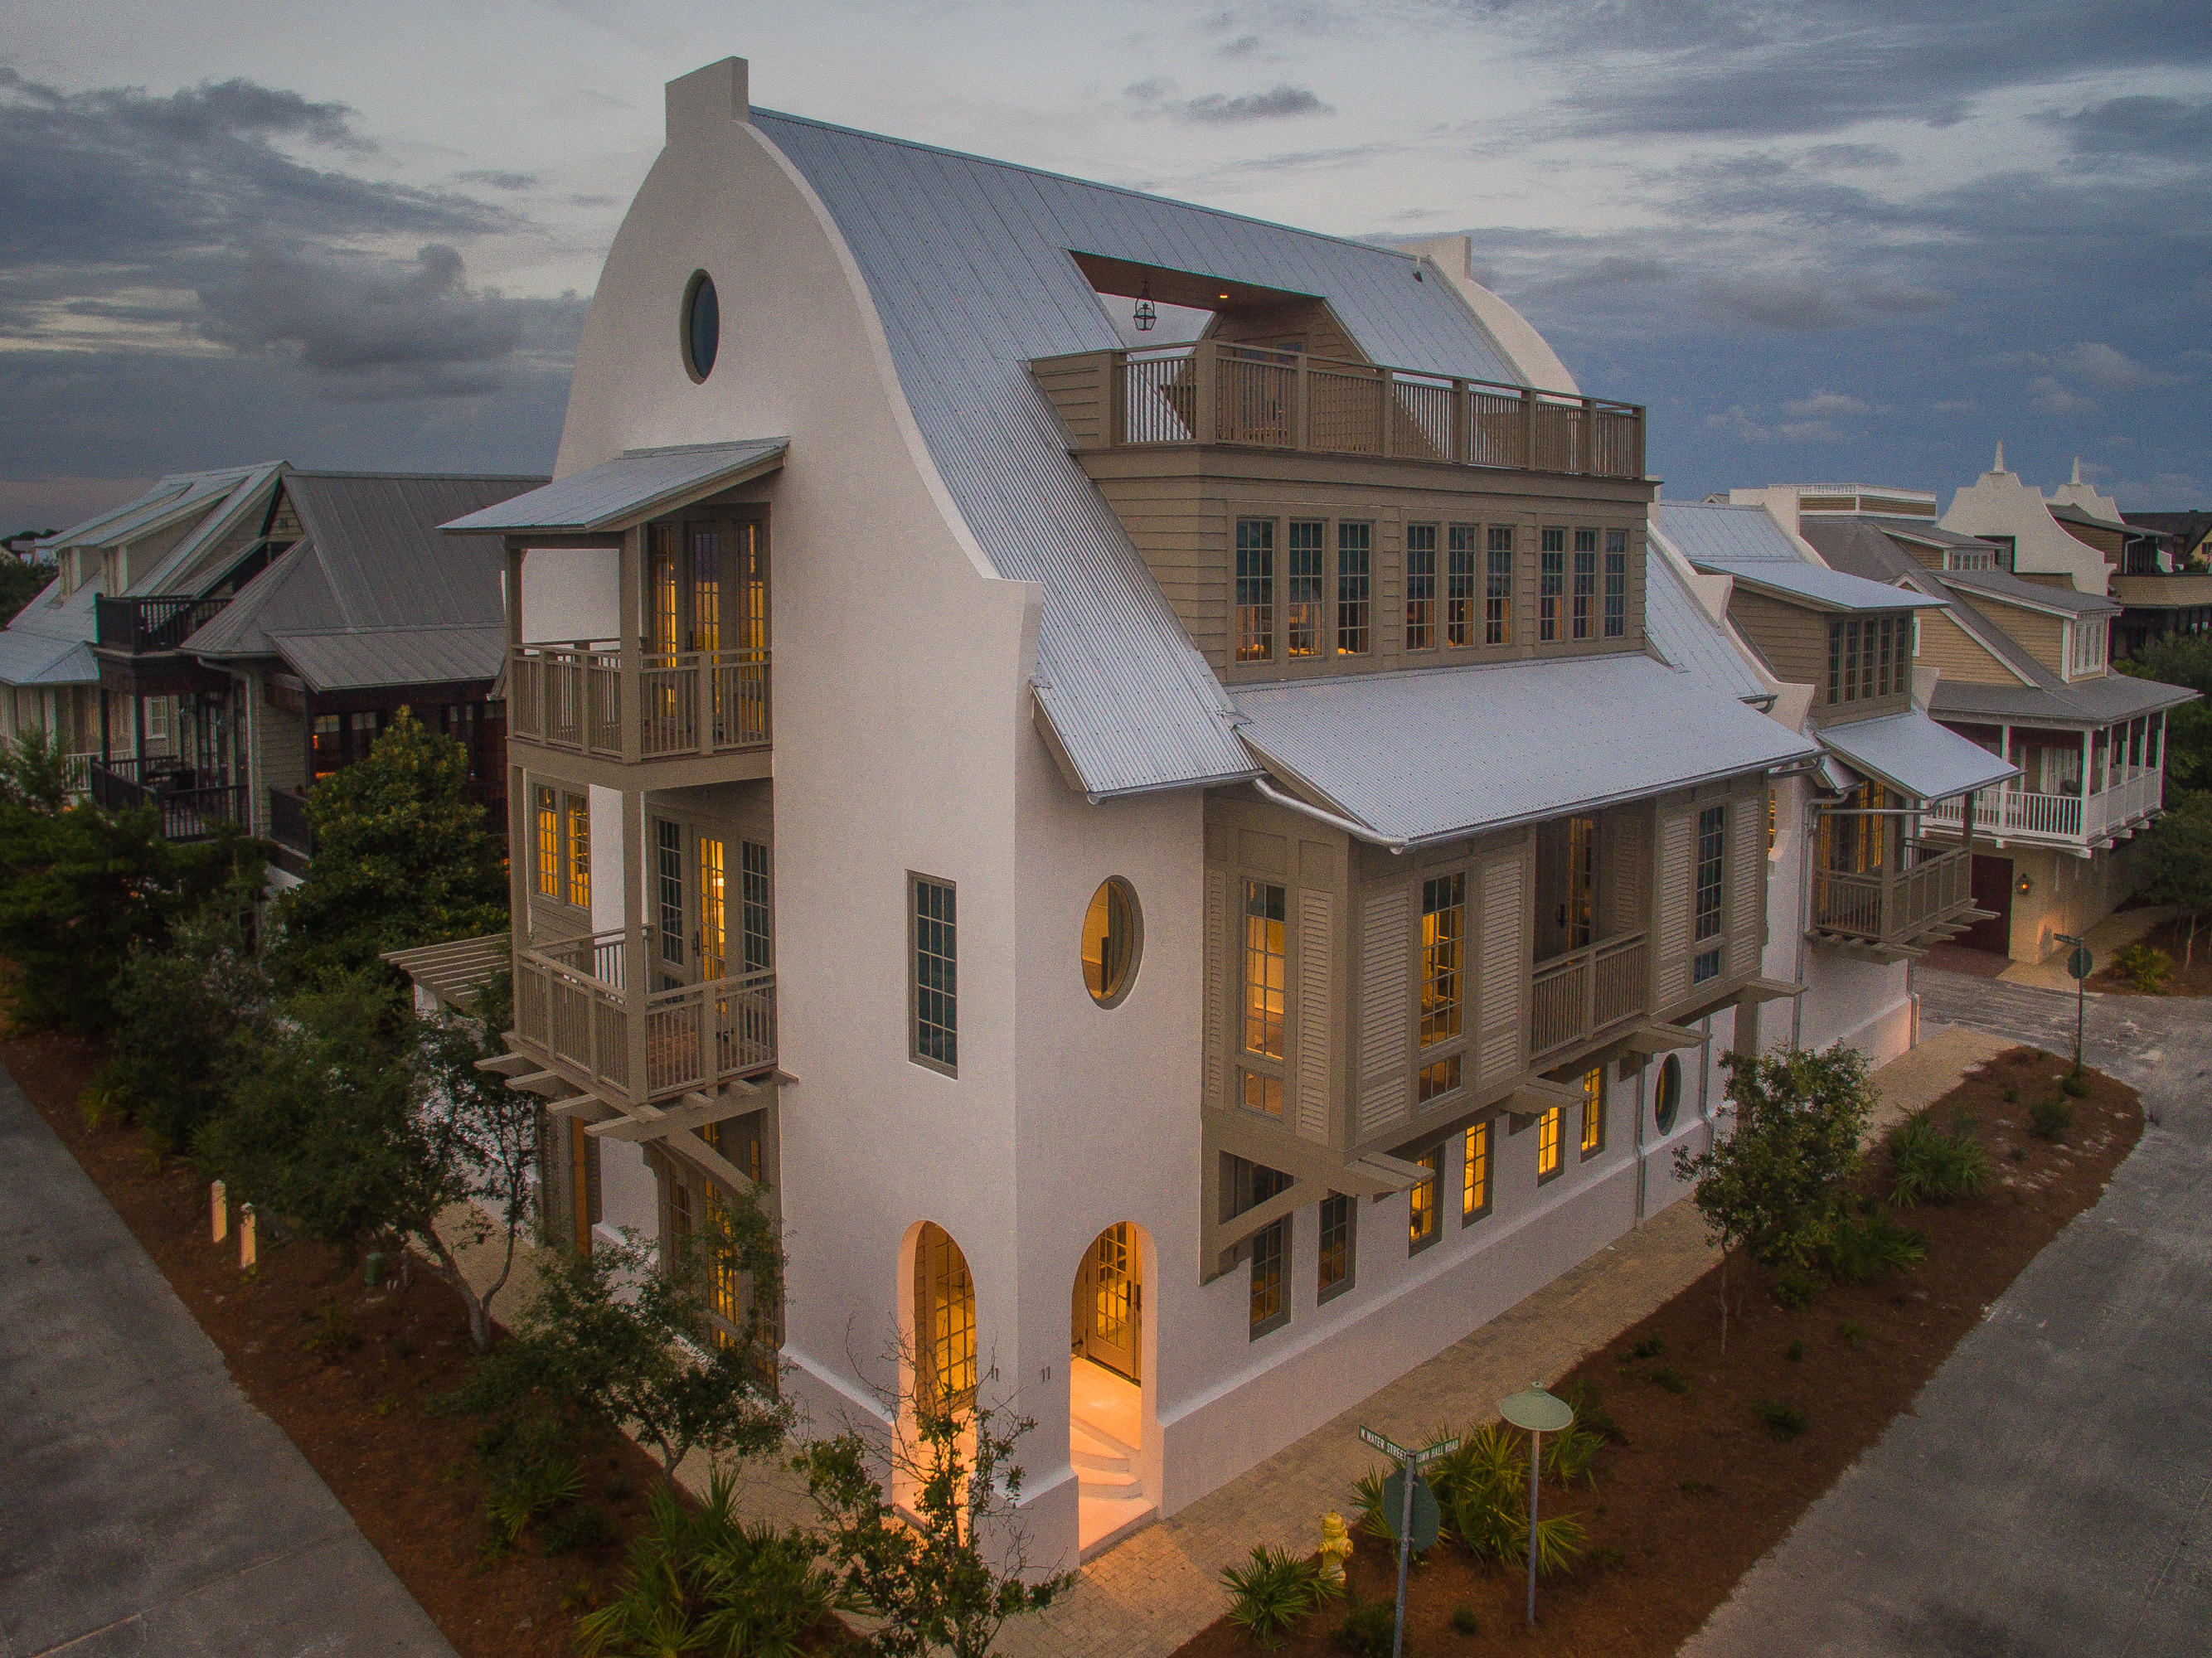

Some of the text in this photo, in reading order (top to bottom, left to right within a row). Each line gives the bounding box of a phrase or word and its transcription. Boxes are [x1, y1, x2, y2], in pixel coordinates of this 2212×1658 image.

[1366, 1431, 1385, 1450] WATER
[1386, 1442, 1407, 1462] STREET
[1416, 1439, 1458, 1464] TOWN HALL ROAD
